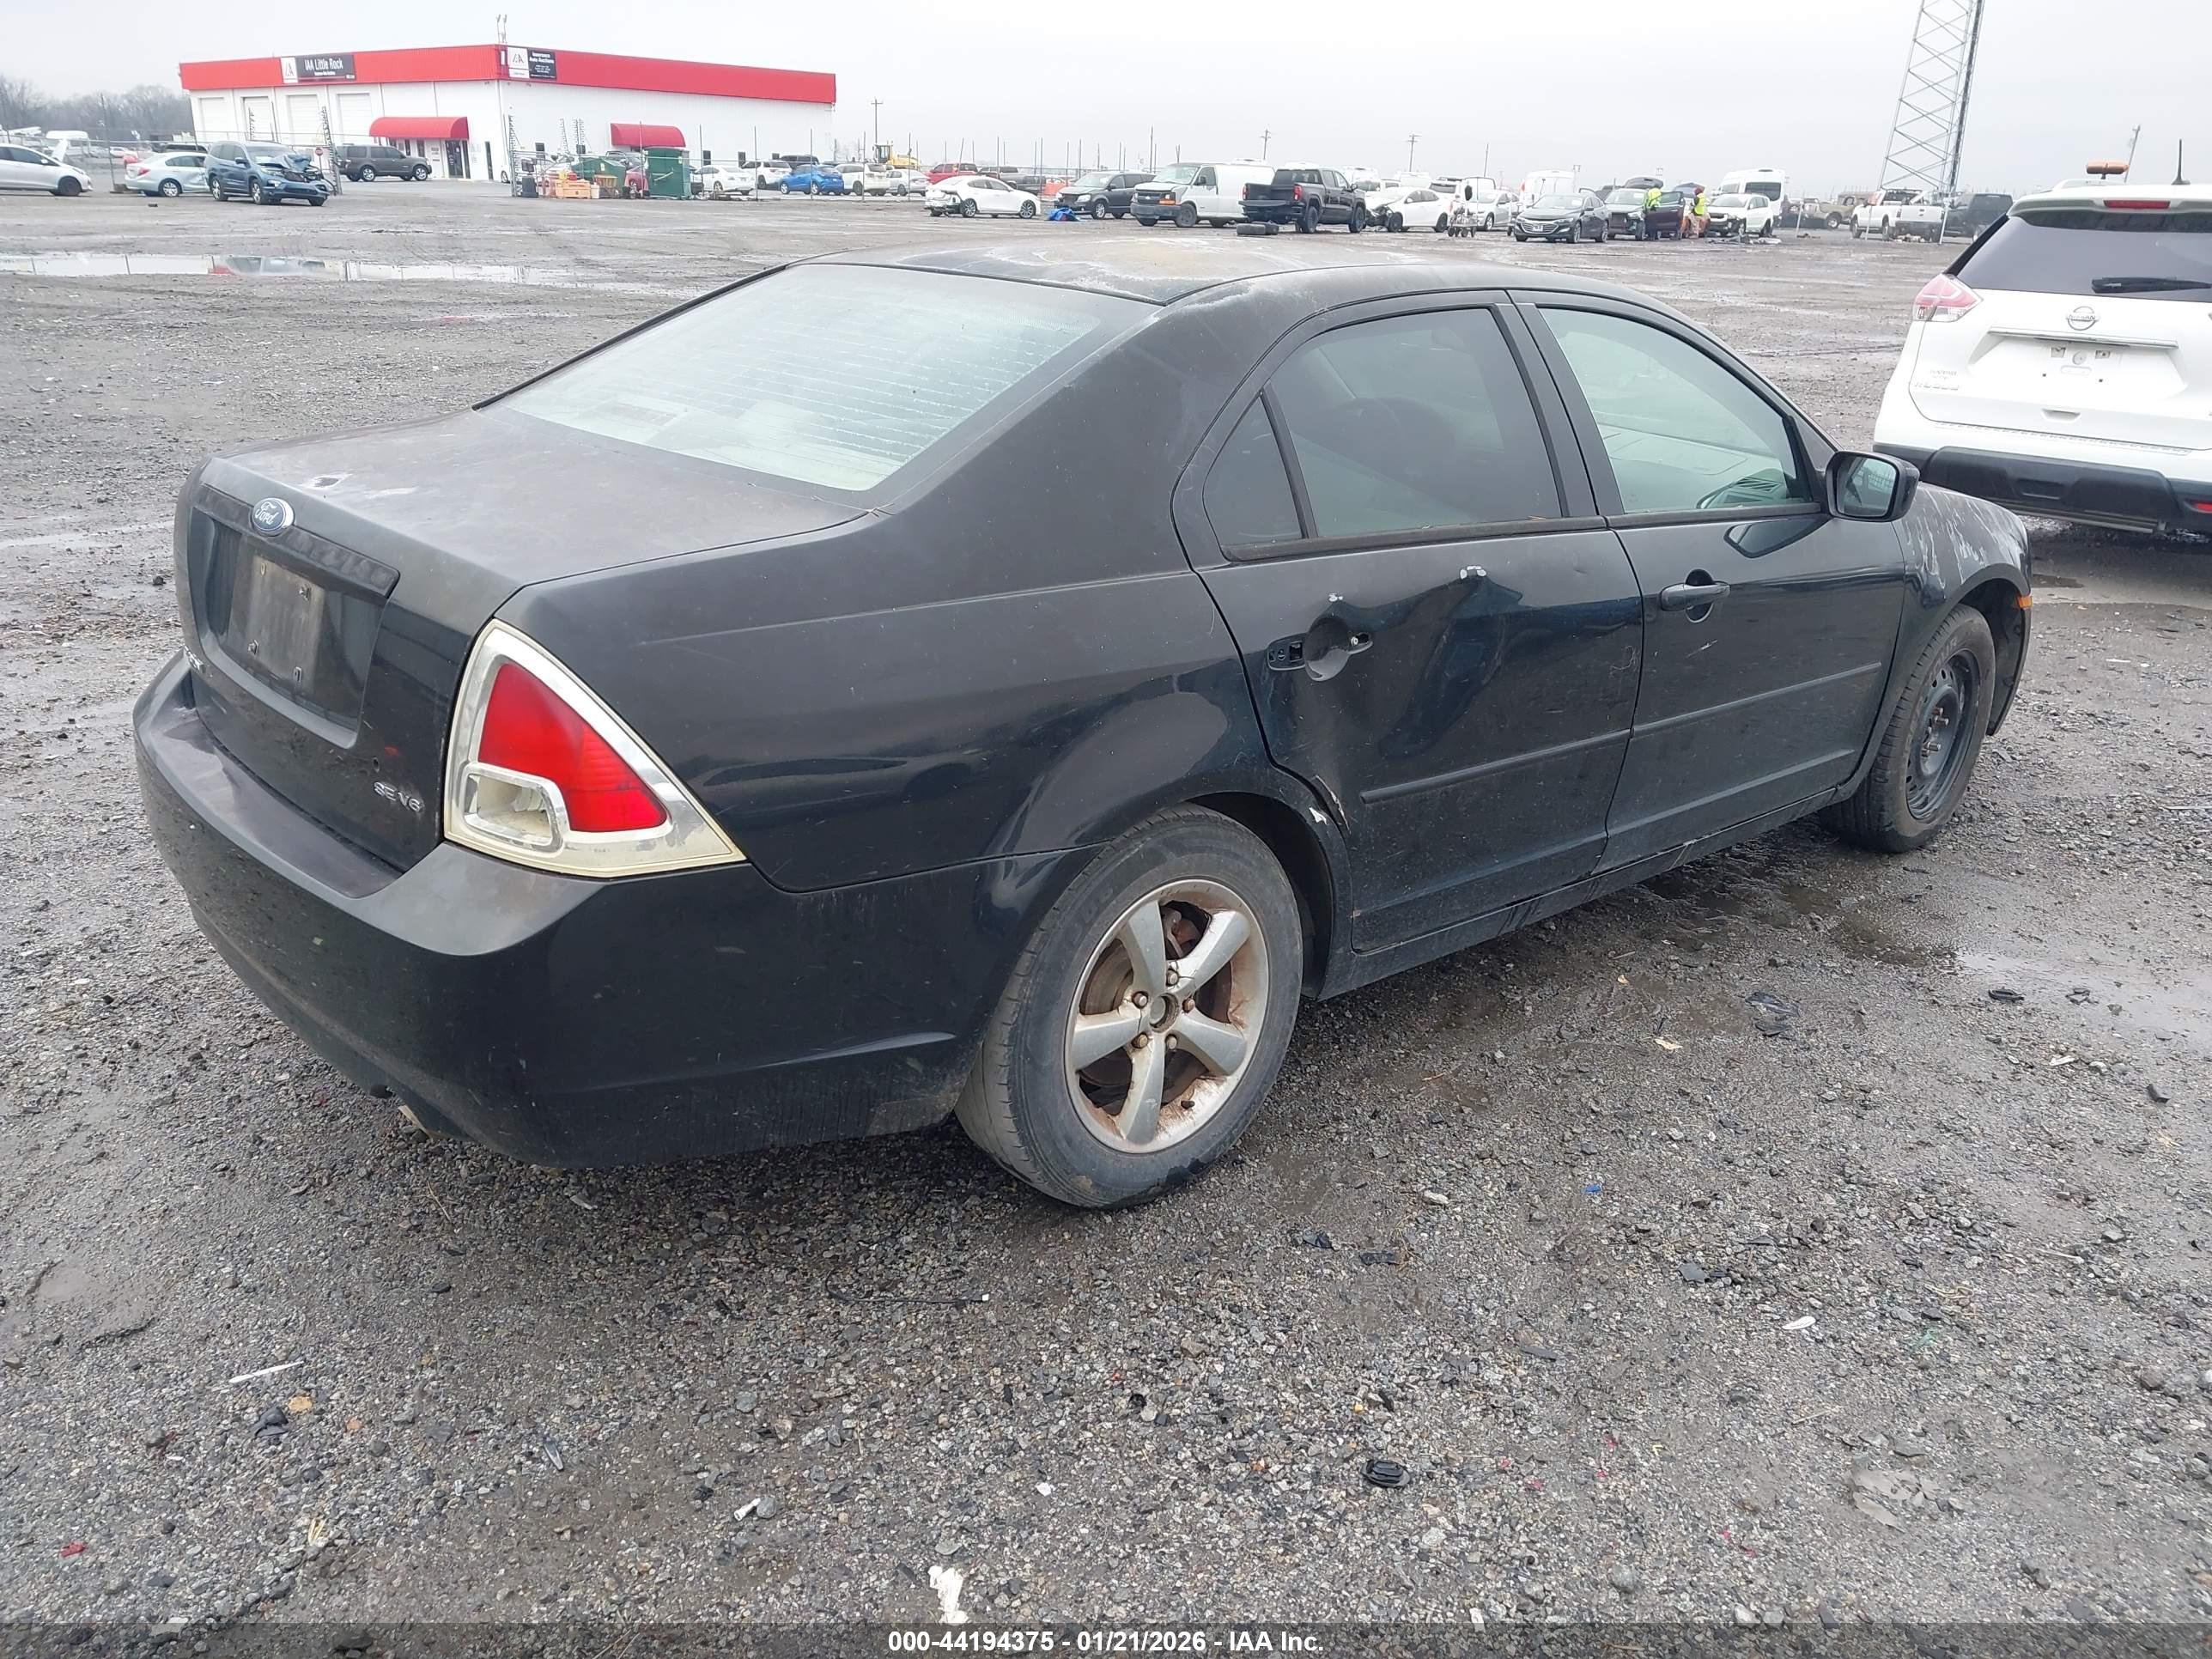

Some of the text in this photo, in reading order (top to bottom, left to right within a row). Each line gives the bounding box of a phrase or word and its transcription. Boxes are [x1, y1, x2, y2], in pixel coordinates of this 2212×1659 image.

[314, 58, 329, 70] Little
[329, 58, 343, 70] Rock
[255, 501, 279, 525] Ford
